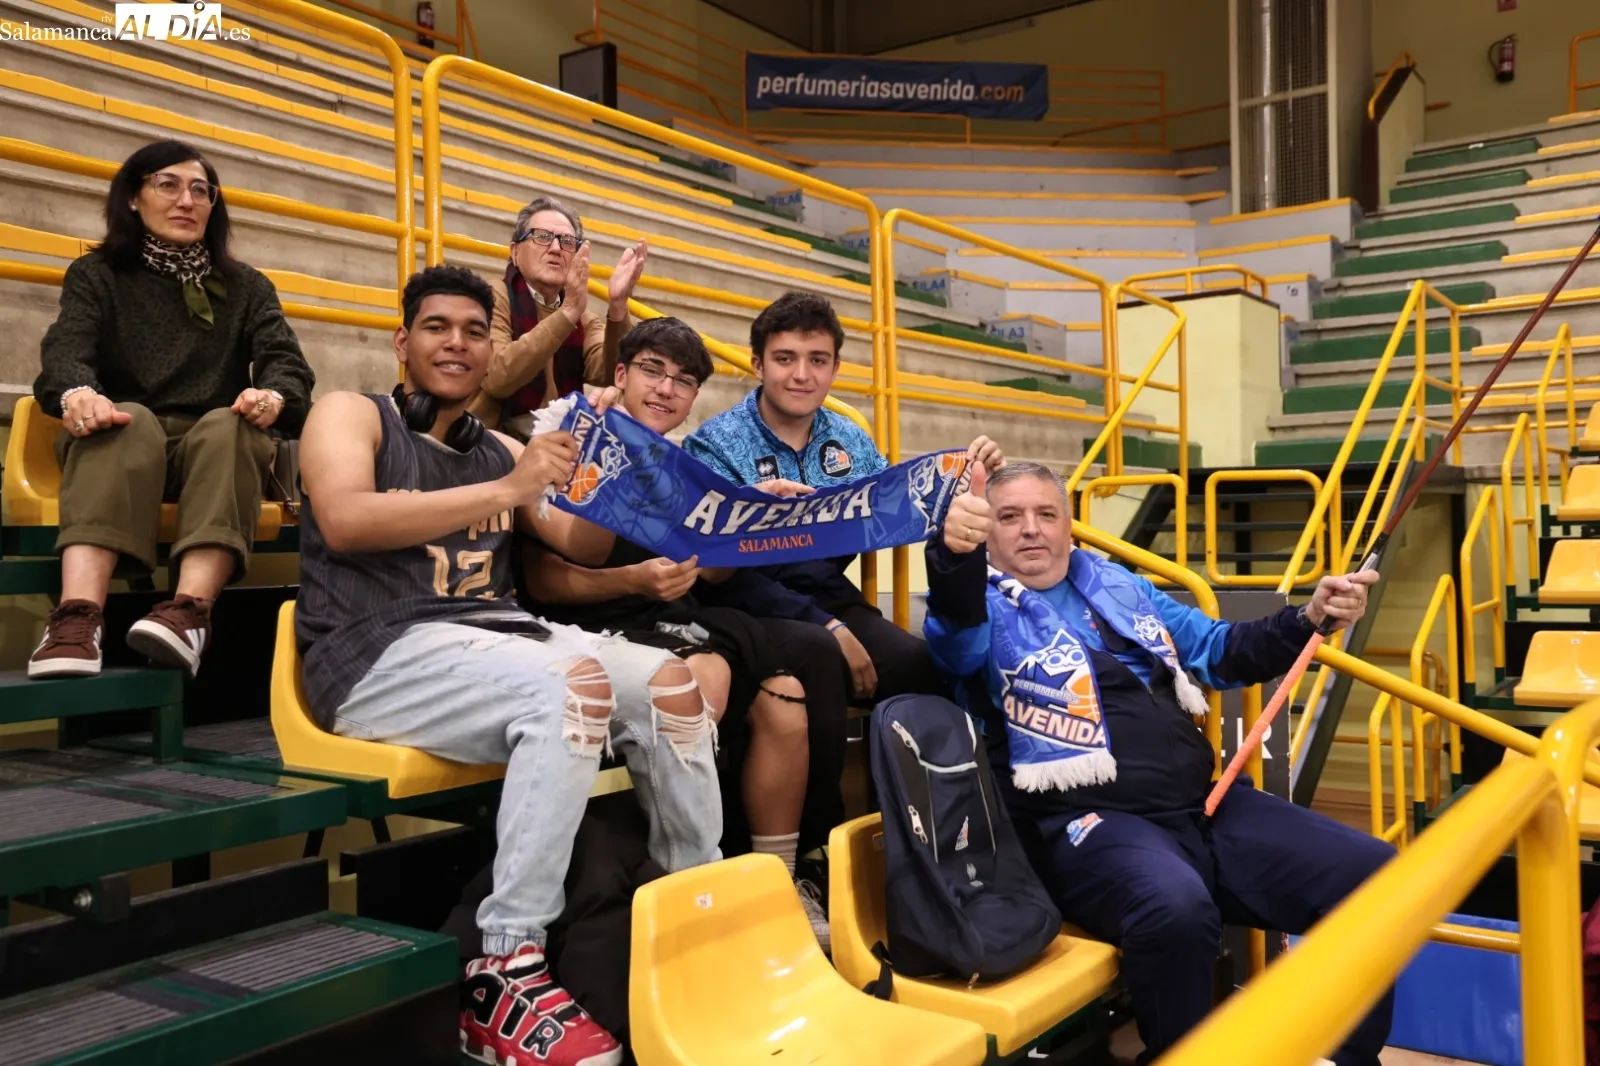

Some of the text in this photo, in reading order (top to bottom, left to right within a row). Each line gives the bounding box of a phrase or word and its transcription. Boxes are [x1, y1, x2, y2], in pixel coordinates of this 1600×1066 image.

[756, 73, 1025, 102] perfumeriasavenida.com
[738, 533, 814, 553] SALAMANCA
[425, 544, 494, 598] 12
[1013, 678, 1080, 704] PERFUMERIAS
[1003, 695, 1107, 745] AVENIDA
[458, 970, 566, 1060] AIR
